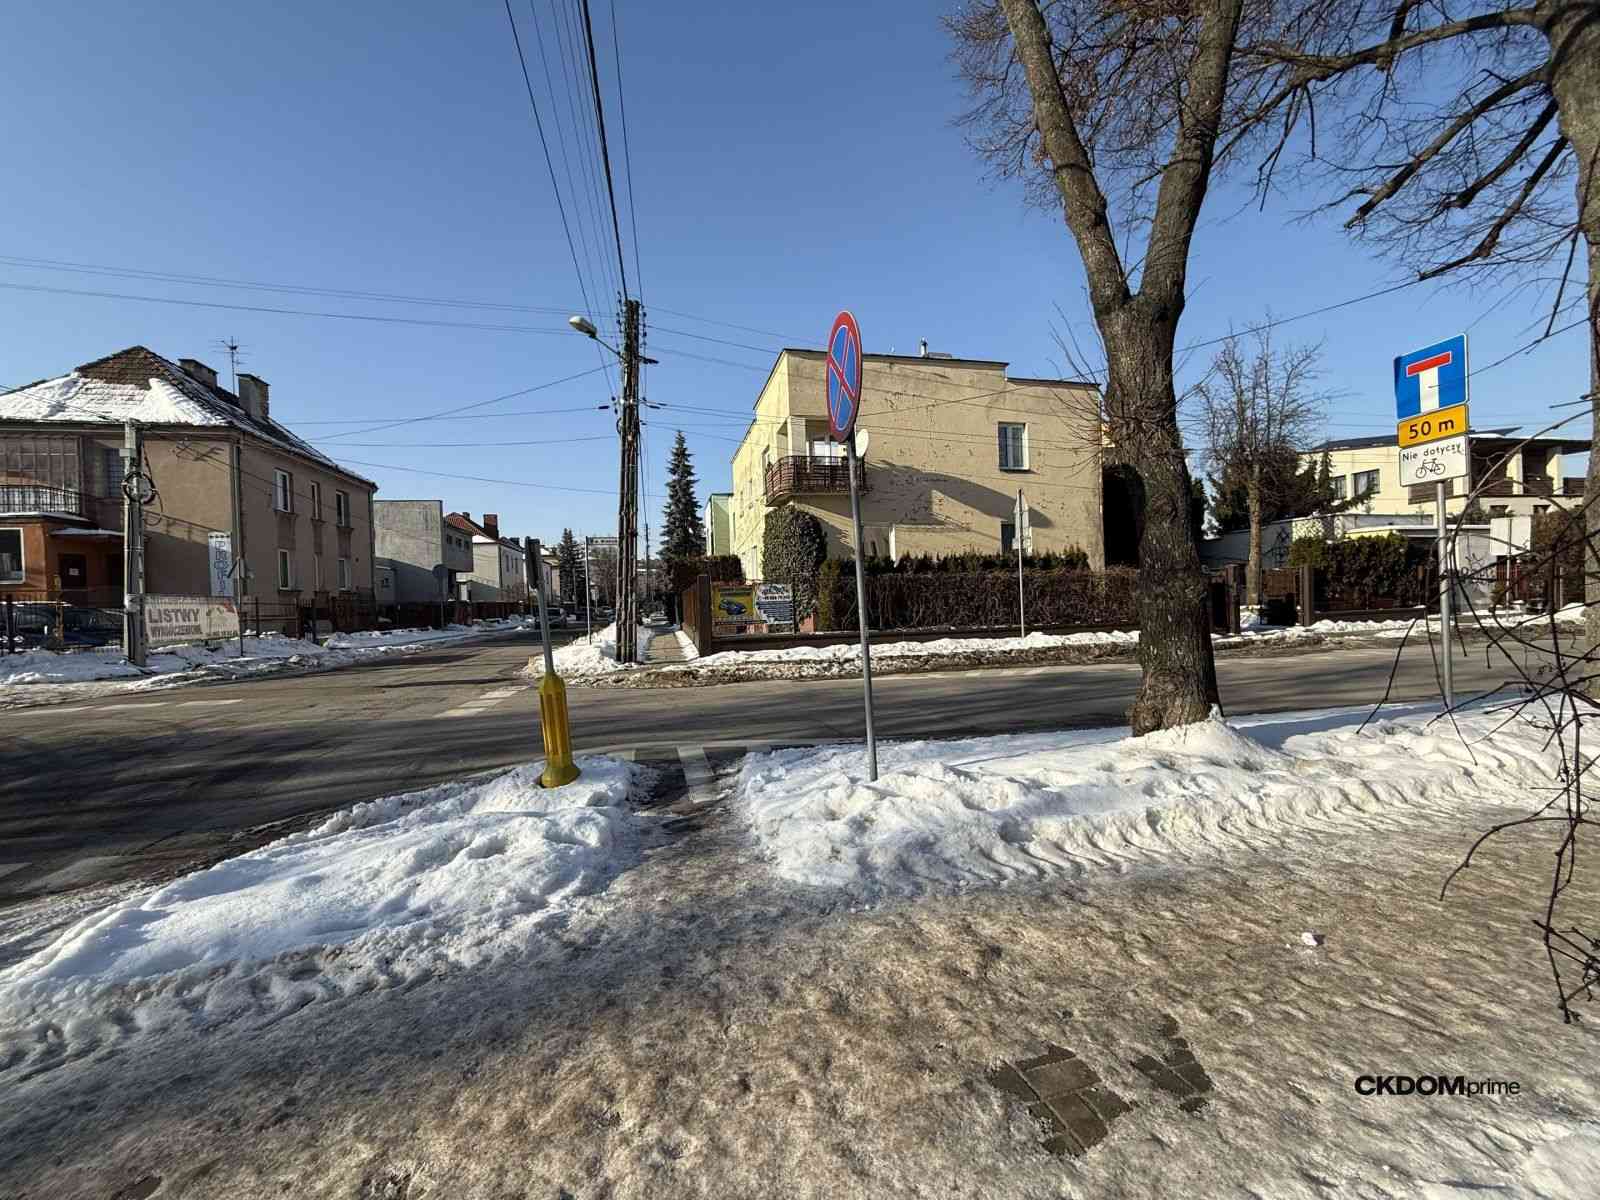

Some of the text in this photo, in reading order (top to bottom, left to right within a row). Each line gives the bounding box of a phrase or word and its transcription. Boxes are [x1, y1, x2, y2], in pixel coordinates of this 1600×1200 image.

[1409, 419, 1455, 440] 50 m
[1402, 451, 1418, 462] Nie
[147, 608, 200, 624] LISTWY
